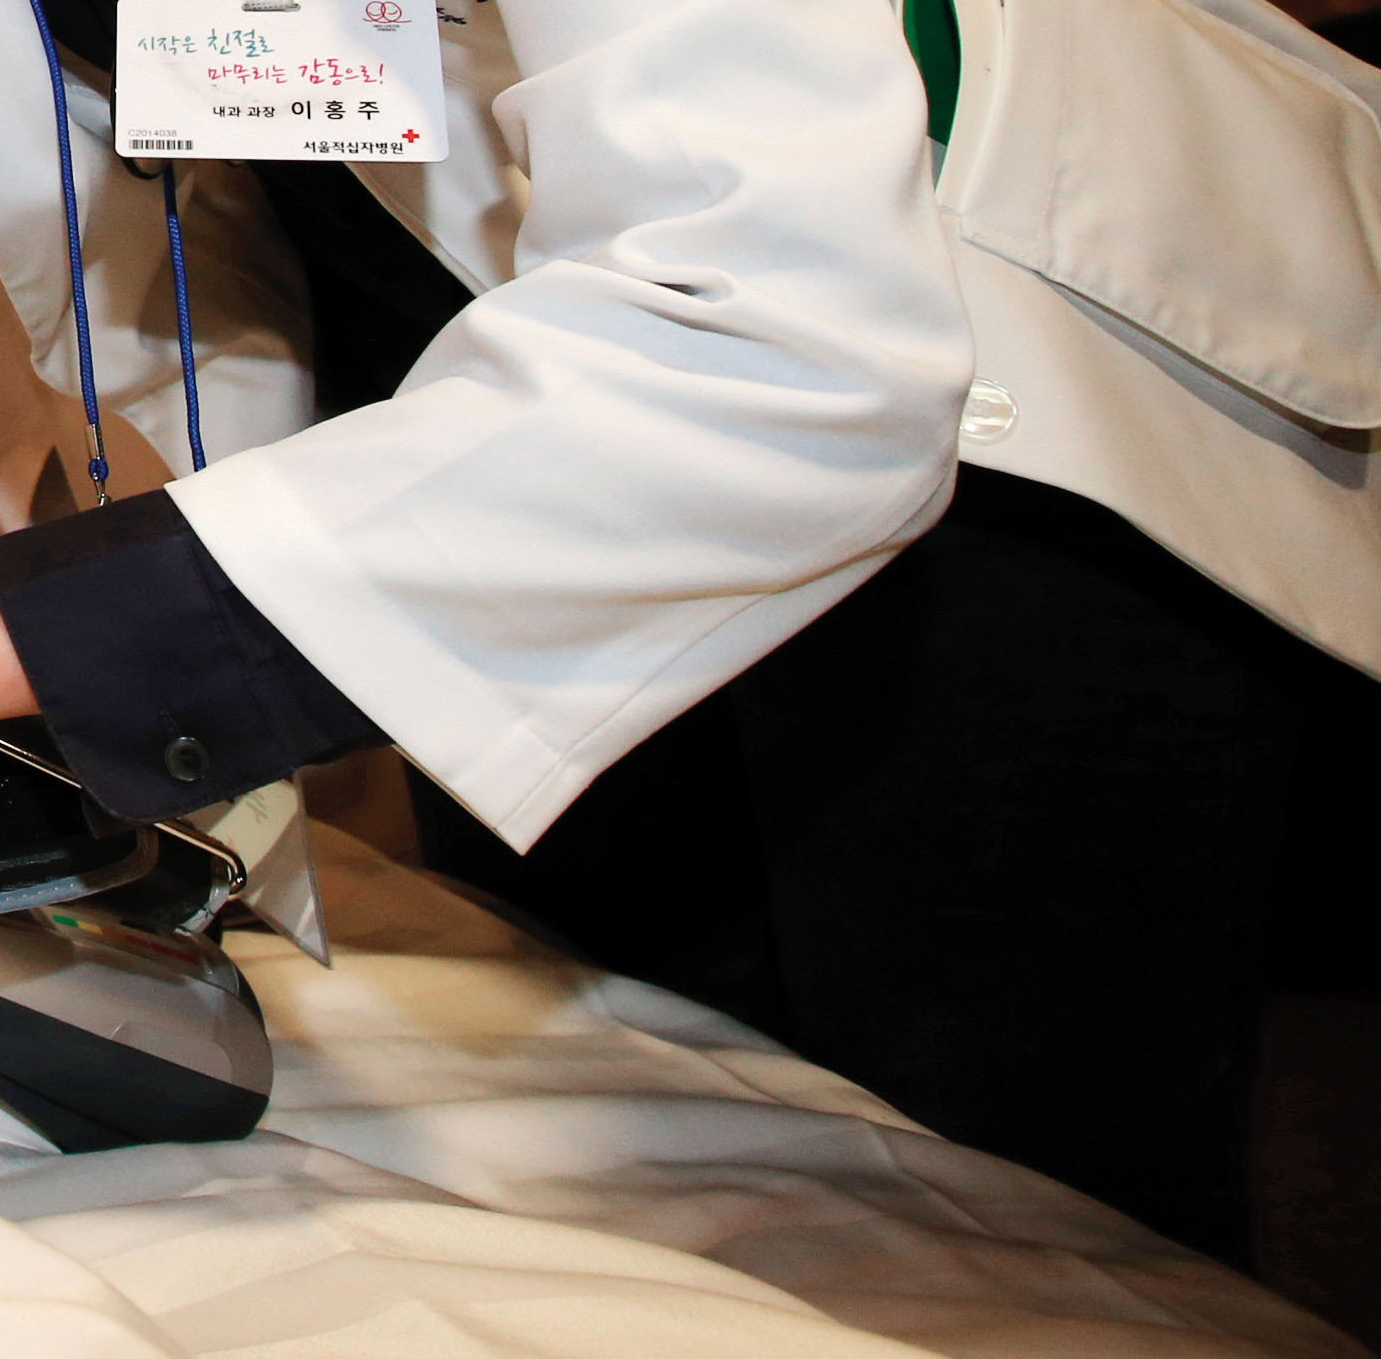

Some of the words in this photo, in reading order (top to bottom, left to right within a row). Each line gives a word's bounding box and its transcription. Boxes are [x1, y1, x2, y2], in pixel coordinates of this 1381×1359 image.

[138, 36, 197, 55] 시작은
[207, 28, 275, 58] 친절로
[208, 64, 288, 84] 마무리는
[298, 58, 385, 86] 감동으로!
[213, 105, 241, 118] 내과
[247, 105, 276, 118] 과장
[303, 140, 405, 155] 서울적십자병원
